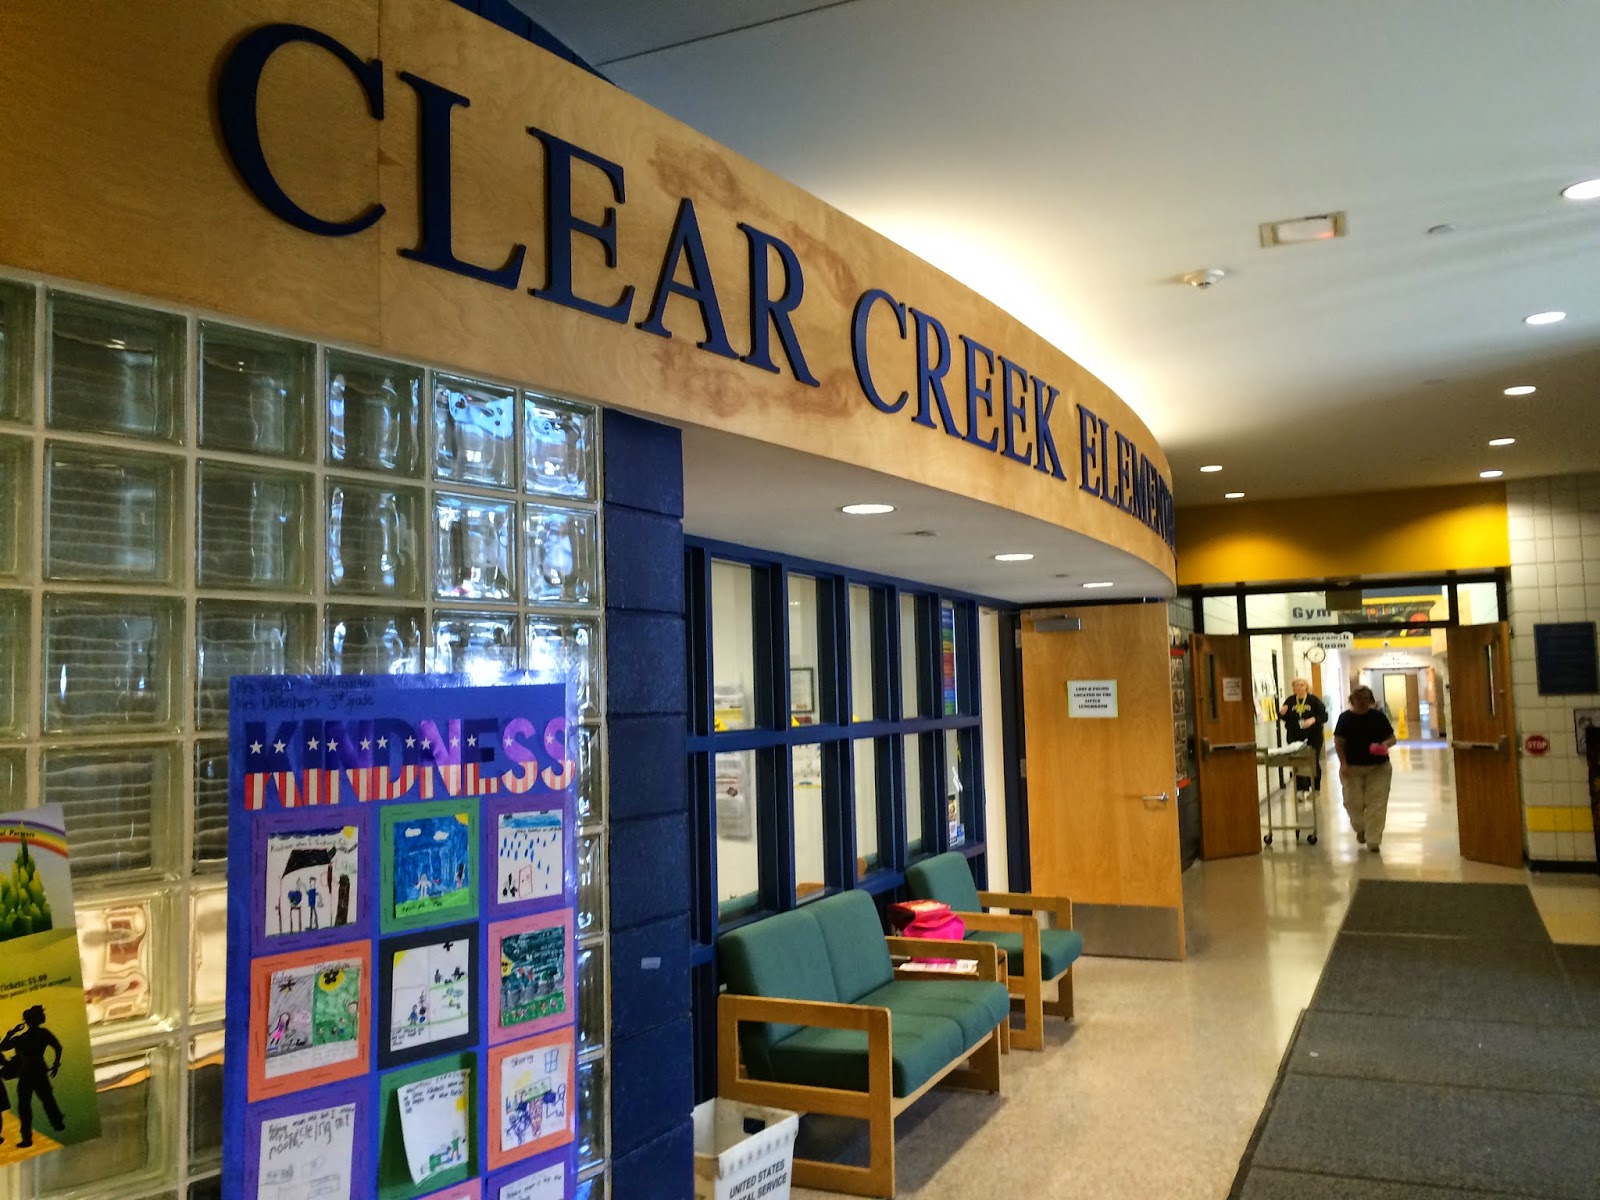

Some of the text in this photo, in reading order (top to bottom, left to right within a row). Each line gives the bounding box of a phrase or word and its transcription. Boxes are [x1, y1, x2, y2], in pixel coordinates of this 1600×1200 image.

[217, 23, 821, 388] CLEAR
[850, 288, 1067, 482] CREEK
[1292, 607, 1332, 619] Gym
[1527, 740, 1547, 749] STOP
[244, 716, 576, 811] KINDNESS
[729, 1158, 785, 1199] UNITED STATES
[757, 1172, 788, 1199] SERVICE
